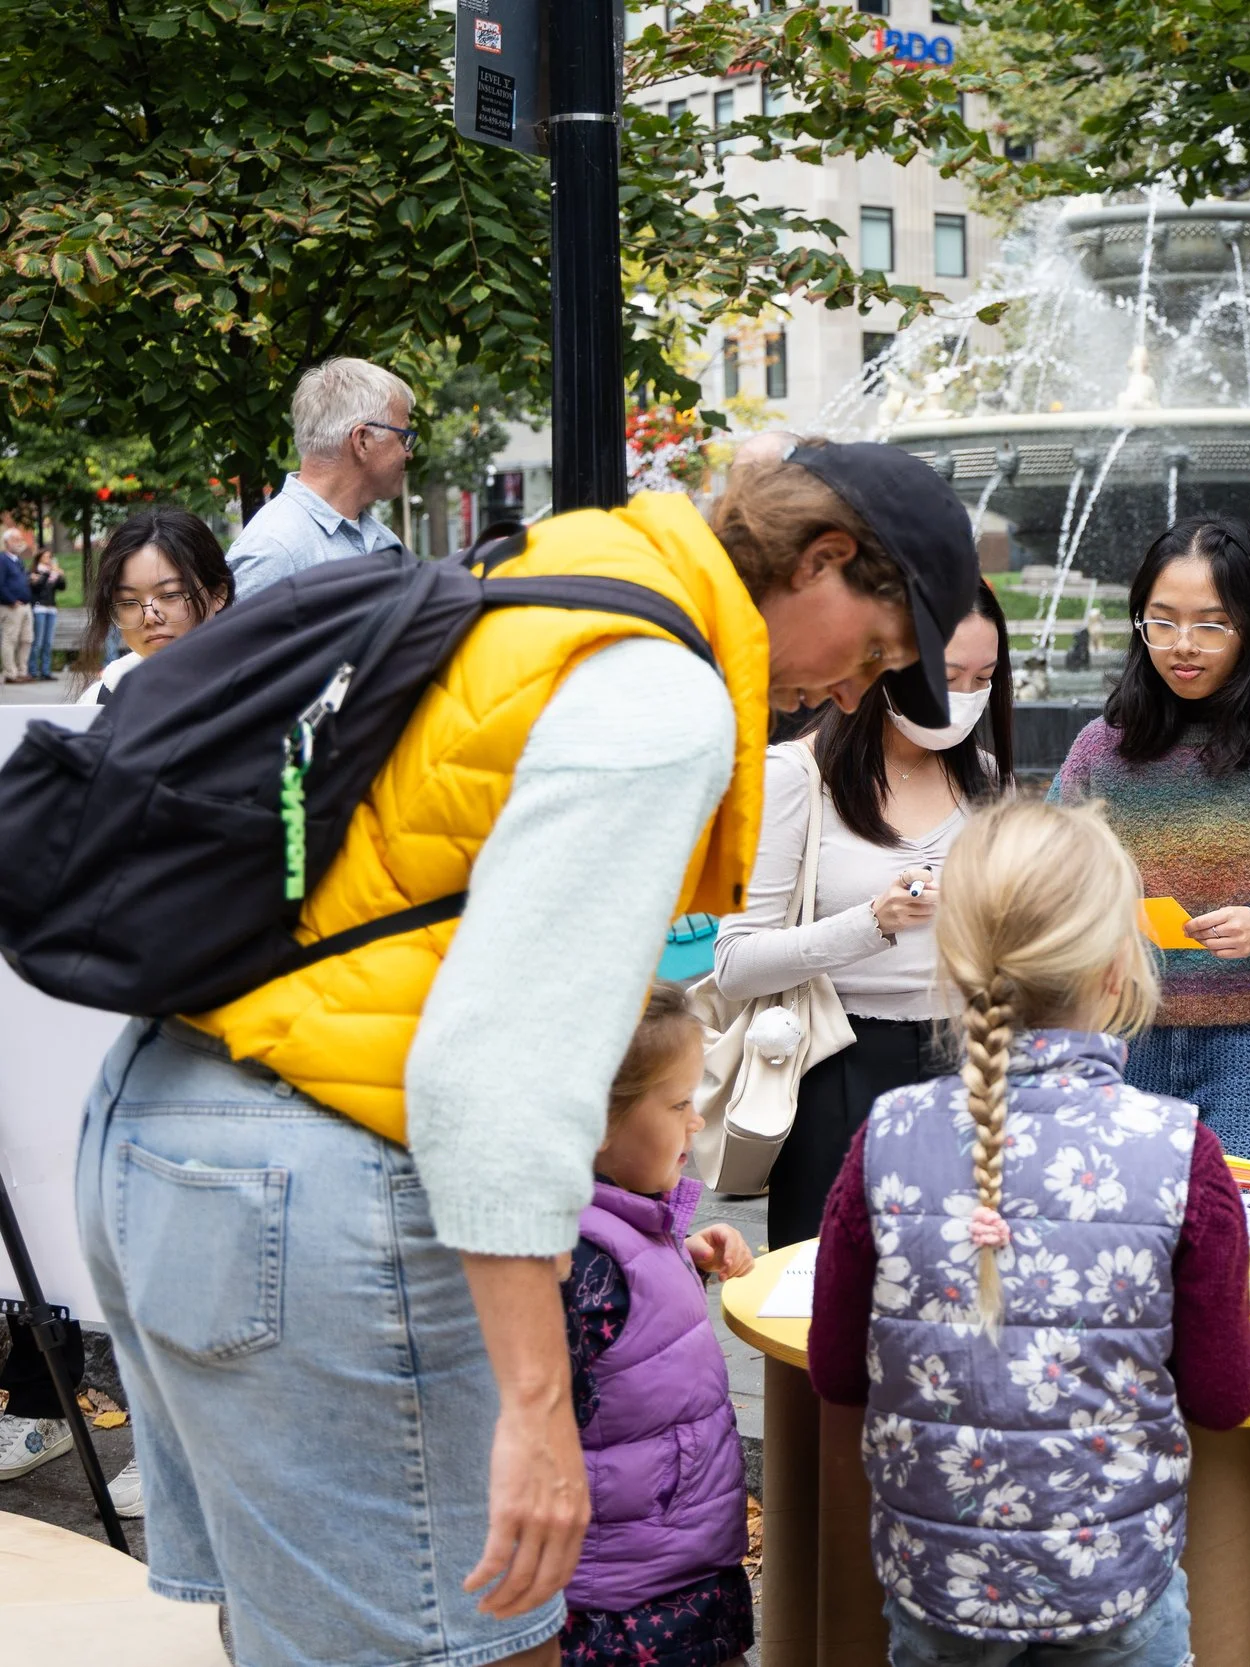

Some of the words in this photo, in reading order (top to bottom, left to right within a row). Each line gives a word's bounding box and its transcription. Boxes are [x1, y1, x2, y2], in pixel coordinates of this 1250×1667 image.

[885, 29, 954, 65] BDO
[480, 70, 502, 86] LEVEL
[478, 81, 513, 100] INSULATION
